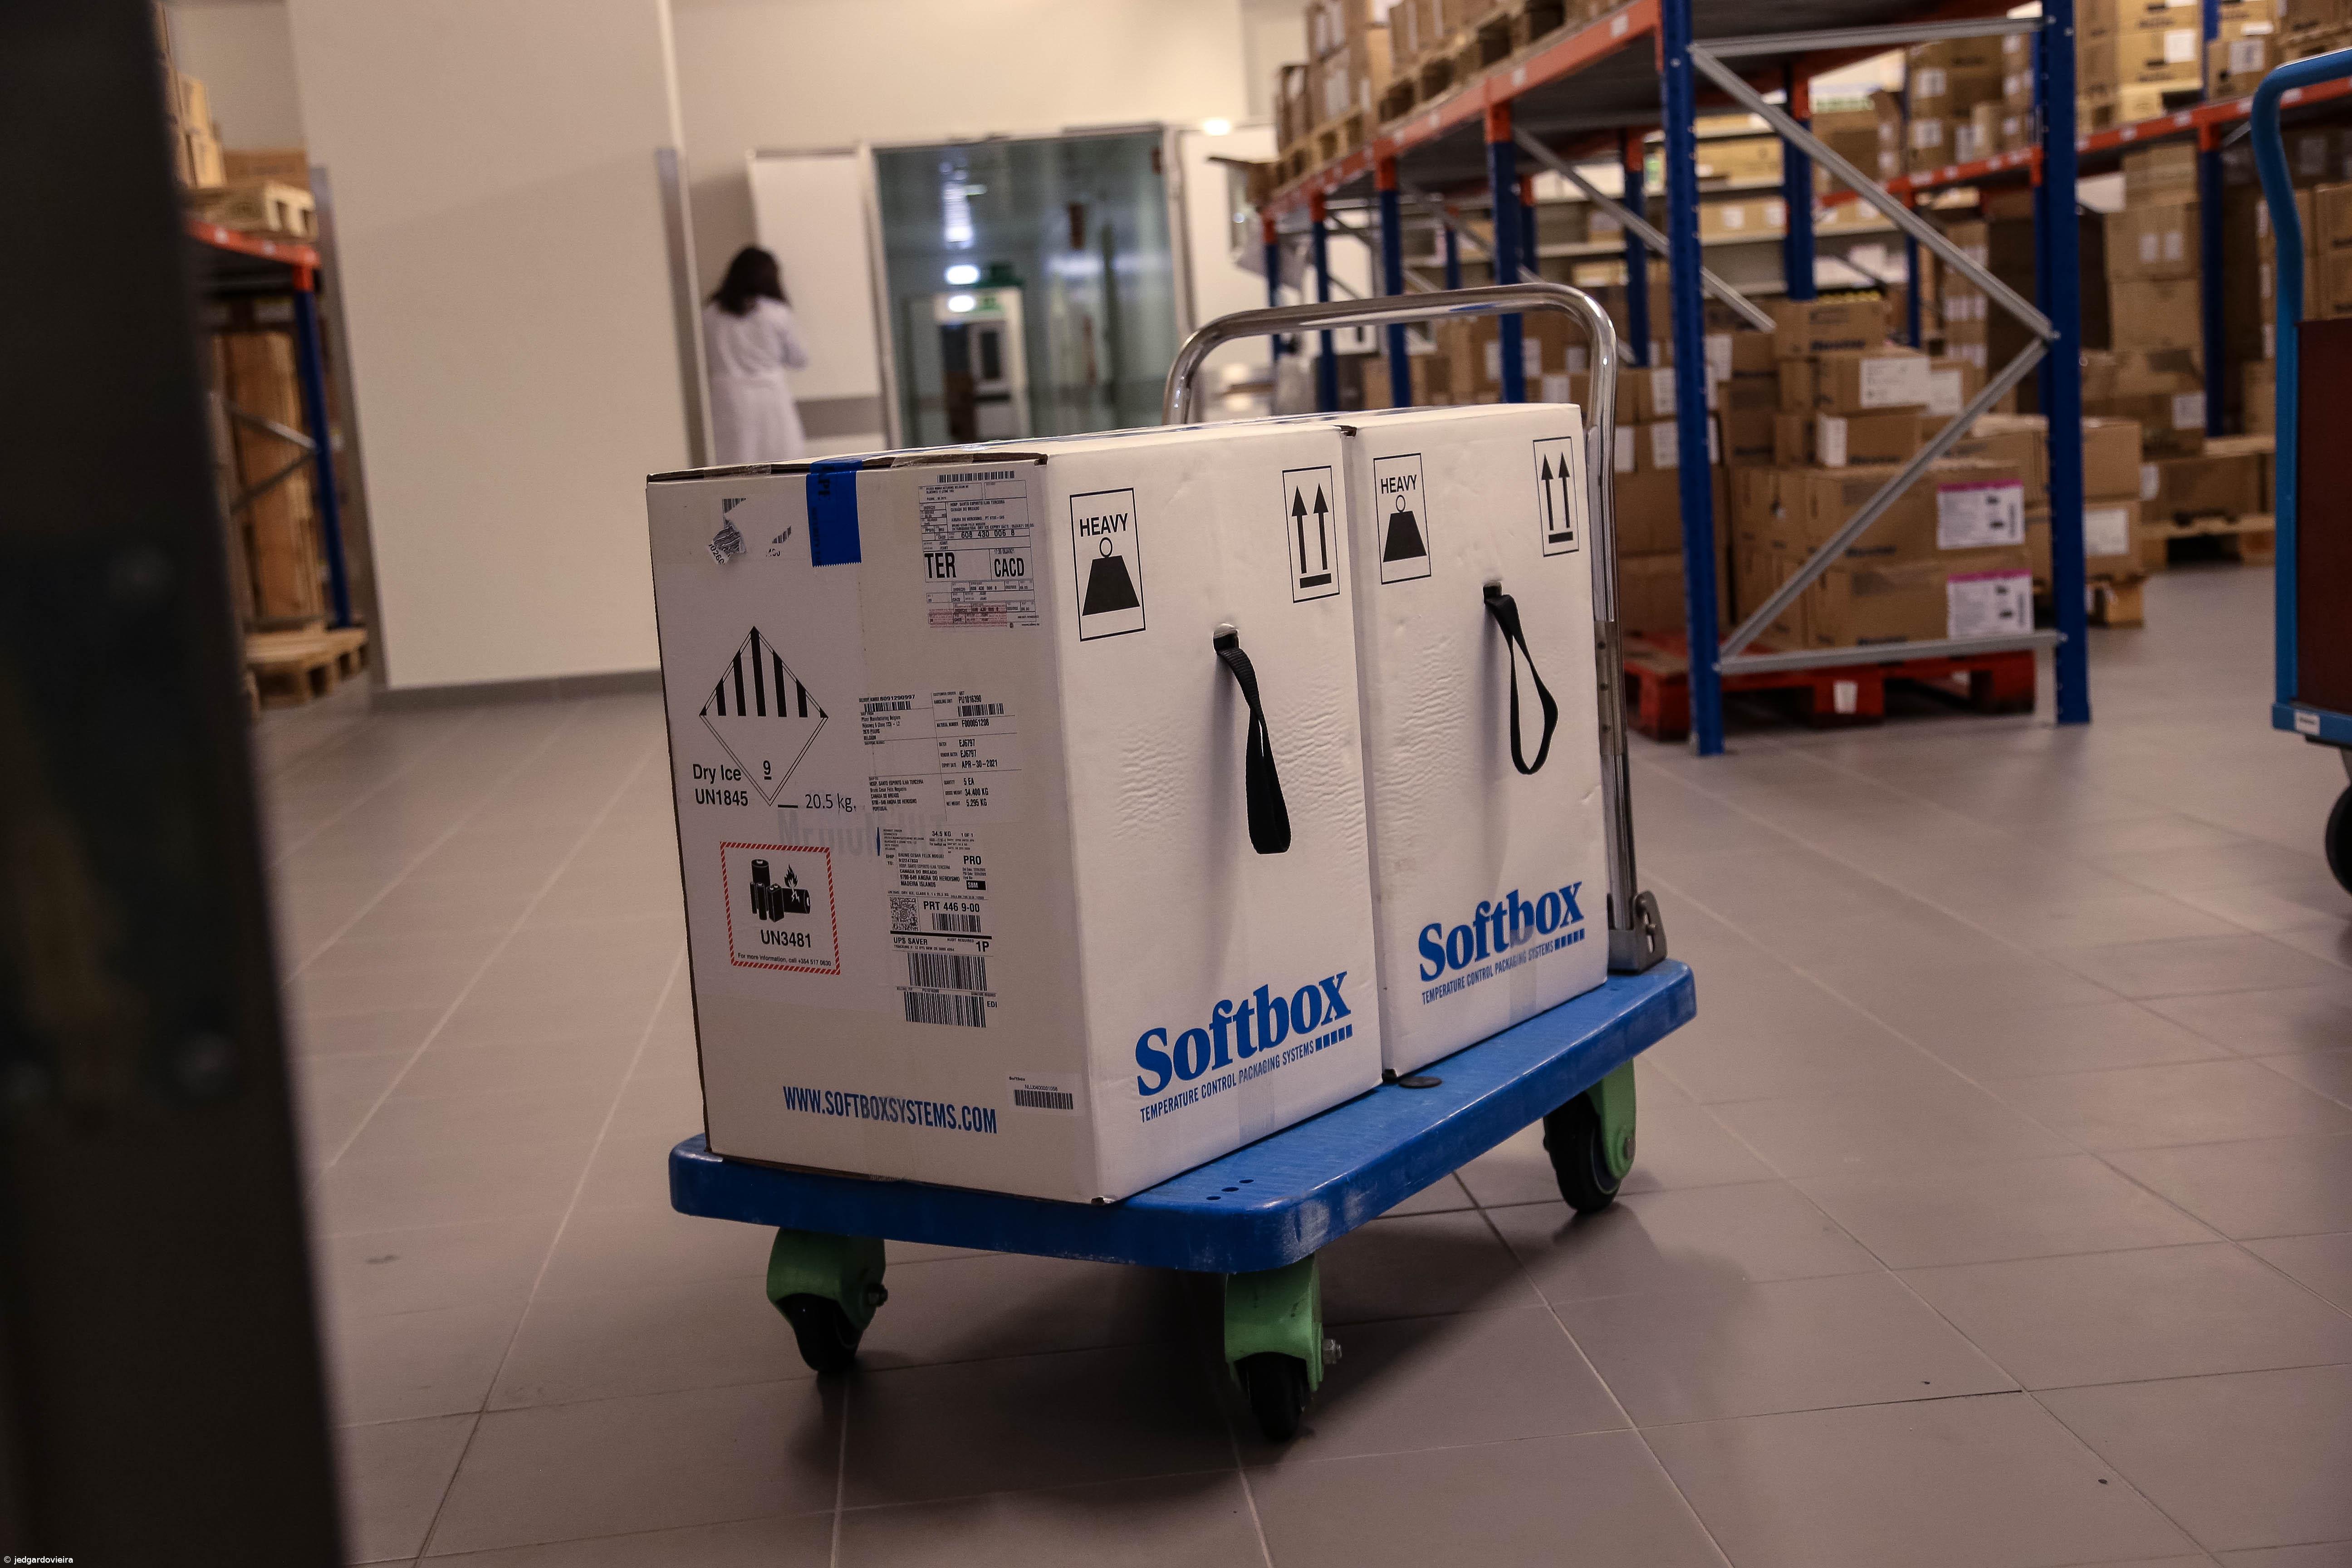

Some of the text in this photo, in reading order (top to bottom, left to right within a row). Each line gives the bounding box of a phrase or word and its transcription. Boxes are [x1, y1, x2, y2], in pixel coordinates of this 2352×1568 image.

[1380, 474, 1418, 494] HEAVY
[1079, 512, 1128, 537] HEAVY
[924, 552, 957, 578] TER
[994, 557, 1024, 578] CACD
[958, 695, 982, 704] PU1016390
[959, 739, 975, 747] EJ6797
[960, 750, 976, 758] EJ6797
[692, 763, 742, 784] Dry Ice
[763, 760, 771, 775] 9
[695, 788, 749, 807] UN1845
[805, 793, 857, 812] 20.5 kg.
[963, 855, 982, 865] PRO
[923, 901, 980, 912] PRT 446 9-00
[760, 929, 811, 948] UN3481
[1419, 881, 1584, 982] Softbox
[976, 941, 990, 952] 1P
[760, 954, 788, 963] information,
[1422, 940, 1555, 1005] TEMPERATURE CONTROL PACKAGING SYSTEMS
[1135, 970, 1352, 1097] Softbox
[1140, 1041, 1315, 1123] TEMPERATURE CONTROL PACKAGING SYSTEMS
[783, 1086, 998, 1134] WWW.SOFTBOXSYSTEMS.COM
